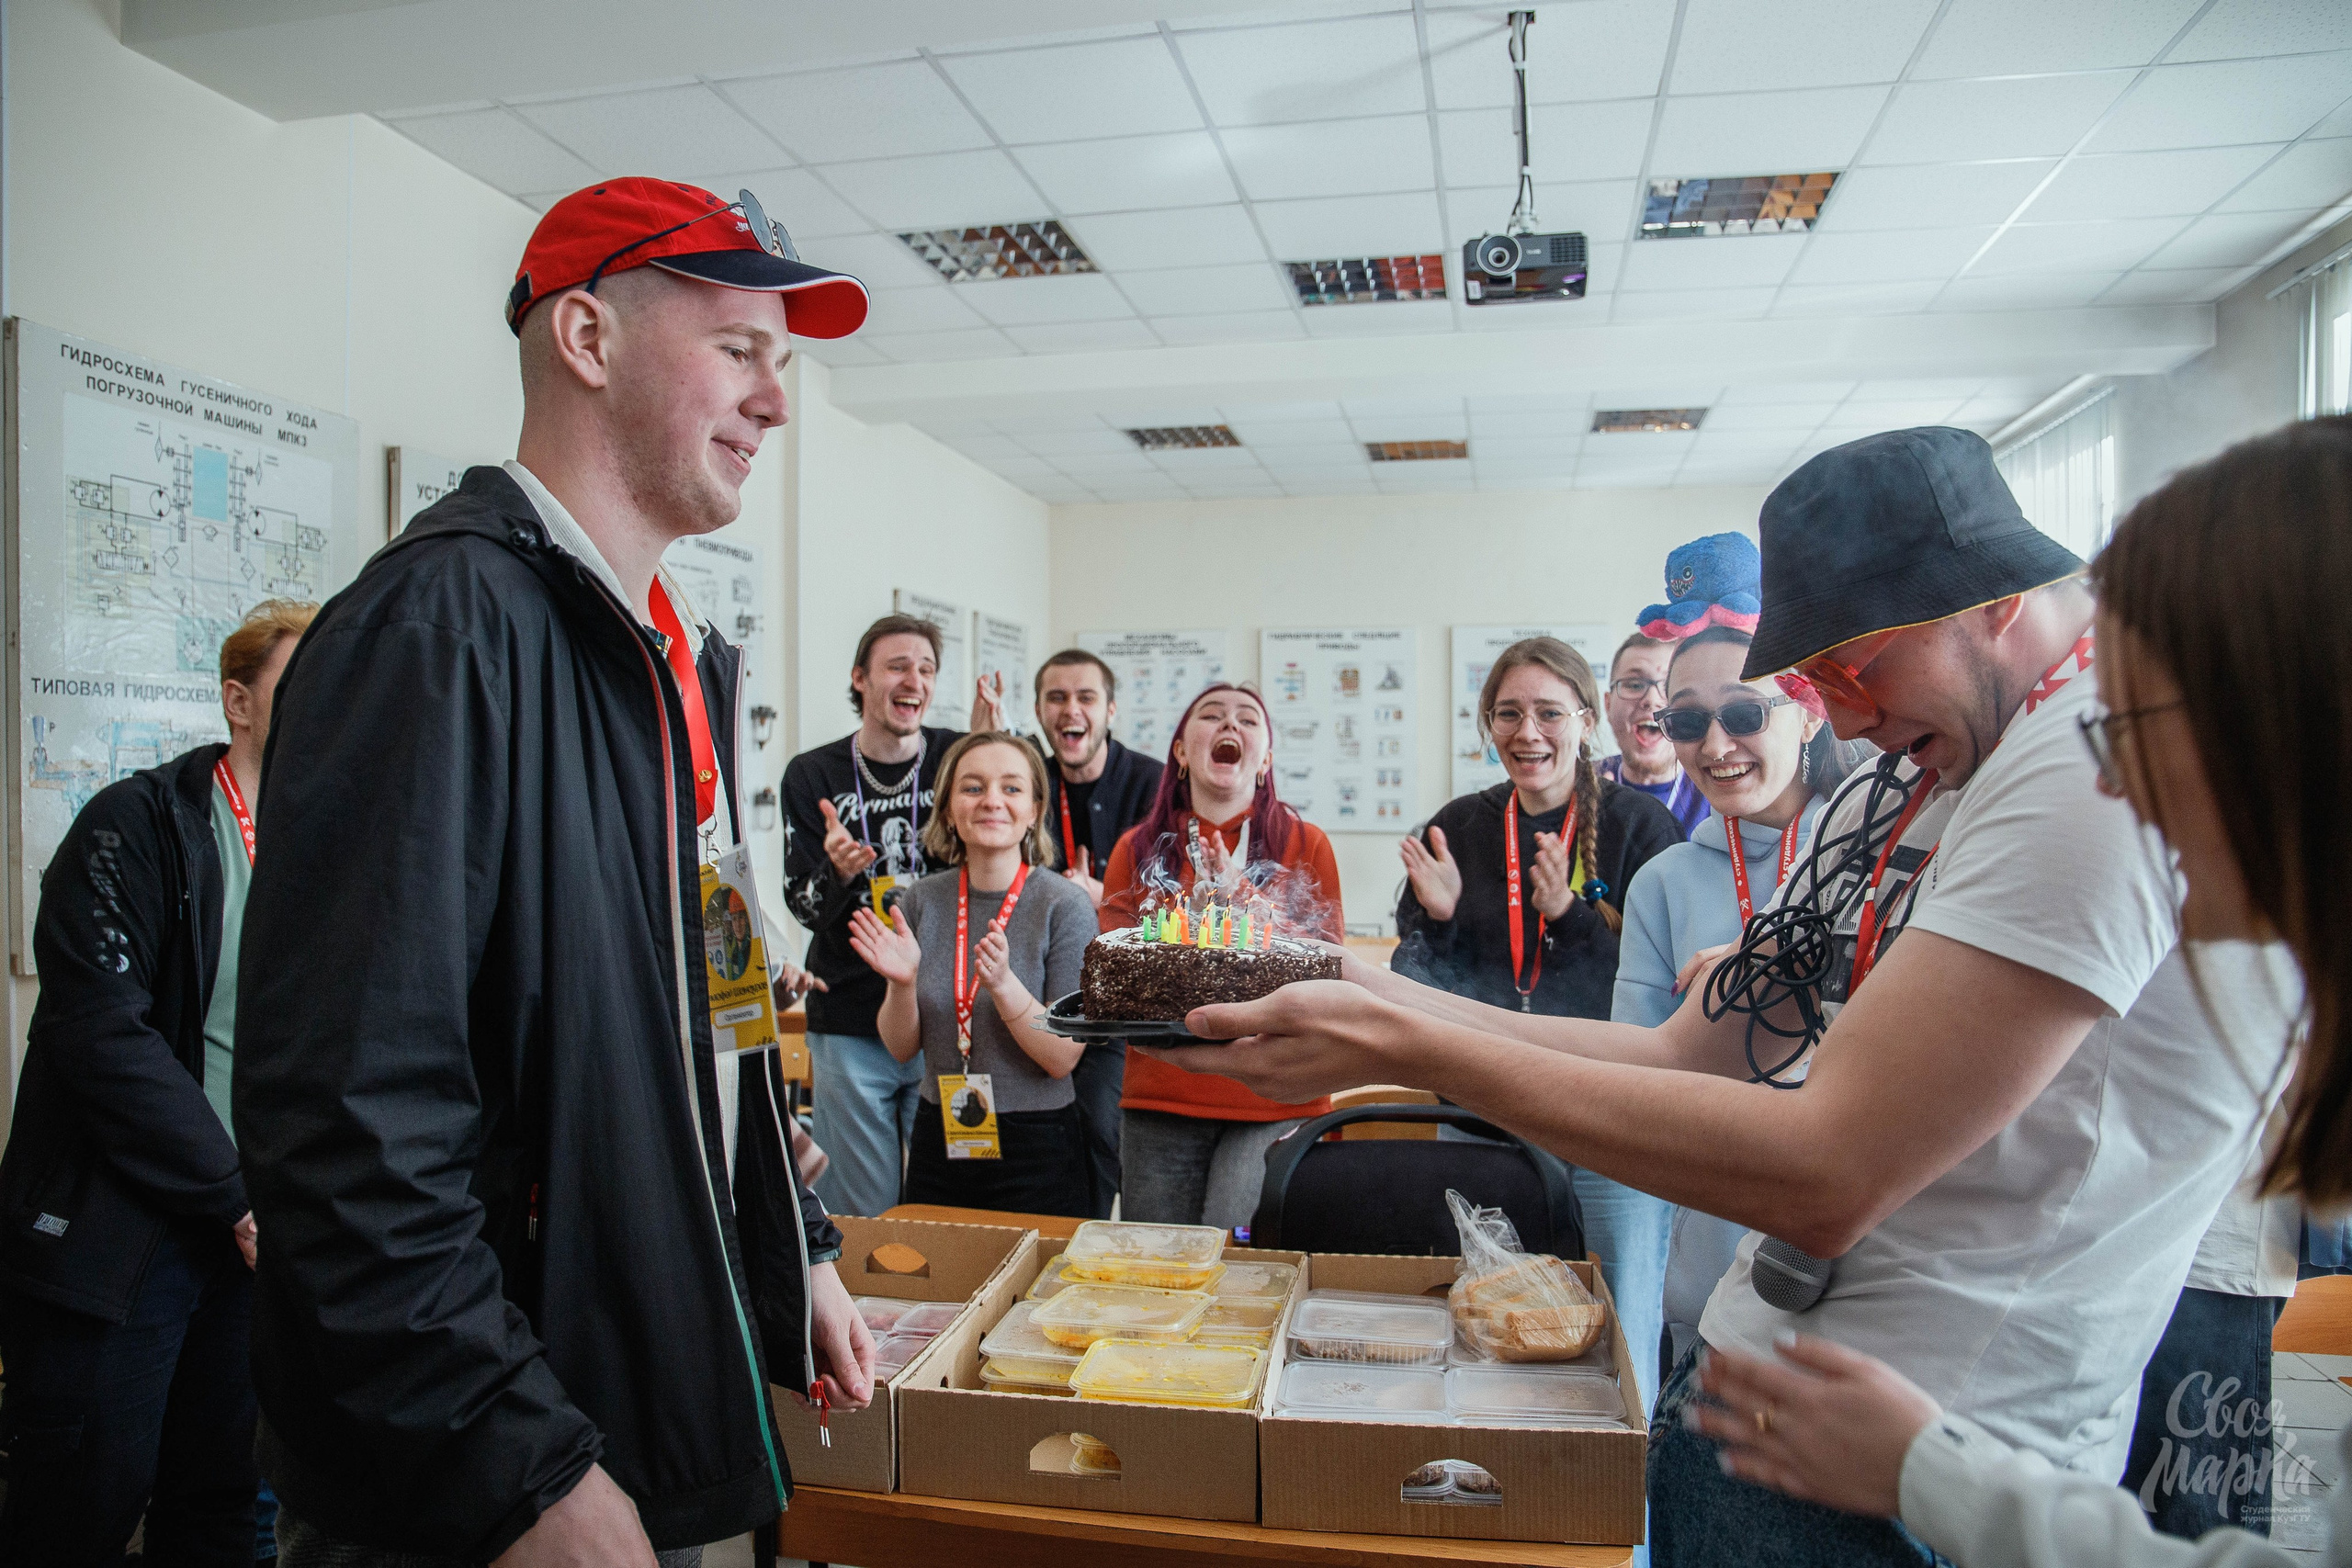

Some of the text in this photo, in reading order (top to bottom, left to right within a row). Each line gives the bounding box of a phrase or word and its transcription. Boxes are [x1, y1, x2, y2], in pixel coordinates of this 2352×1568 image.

[61, 344, 318, 430] ГИДРОСХЕМА ГУСЕНИЧНОГО ХОДА
[86, 376, 193, 416] ПОГРУЗОЧНОЙ
[204, 409, 263, 435] МАШИНЫ
[31, 677, 115, 698] ТИПОВАЯ
[1726, 818, 1741, 877] студенческий
